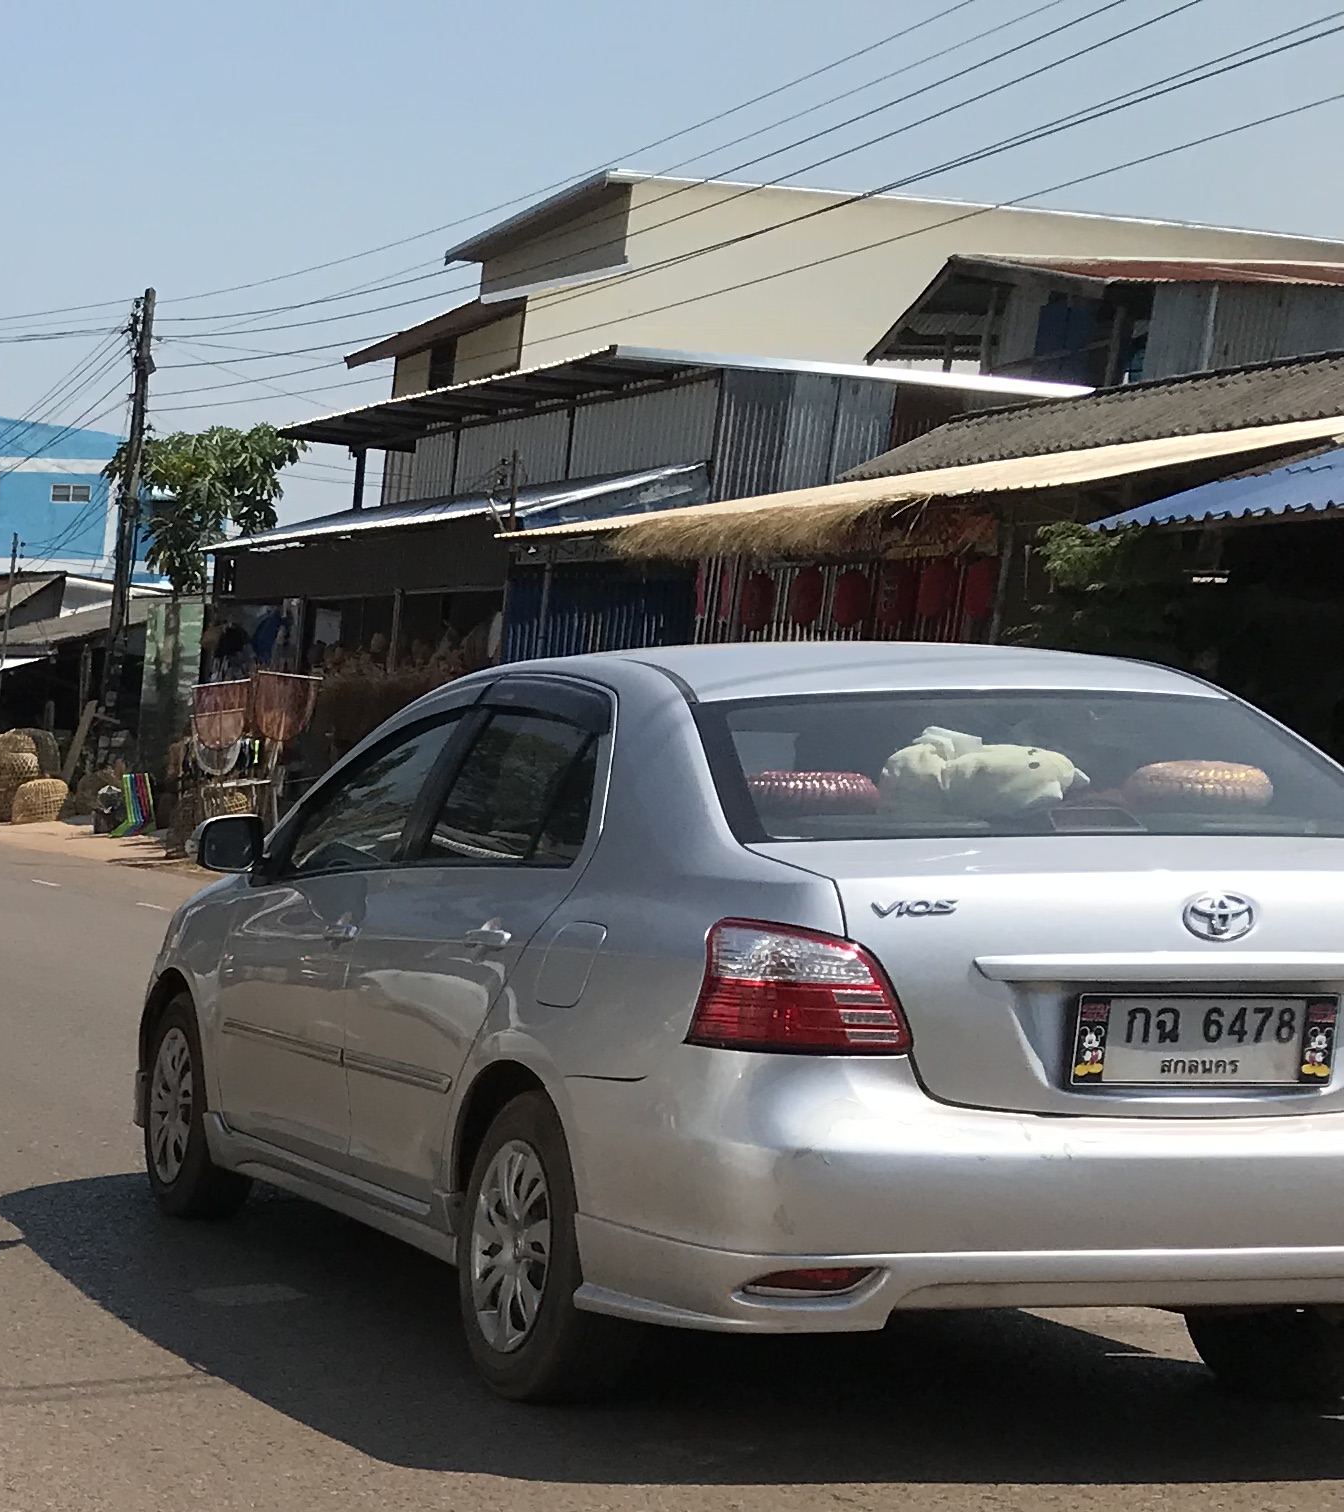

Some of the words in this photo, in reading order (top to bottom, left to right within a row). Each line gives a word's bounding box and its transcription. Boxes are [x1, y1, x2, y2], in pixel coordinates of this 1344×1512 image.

[871, 899, 960, 918] VIOS
[1202, 1006, 1296, 1044] 6478
[1159, 1057, 1239, 1075] สกลนคร
